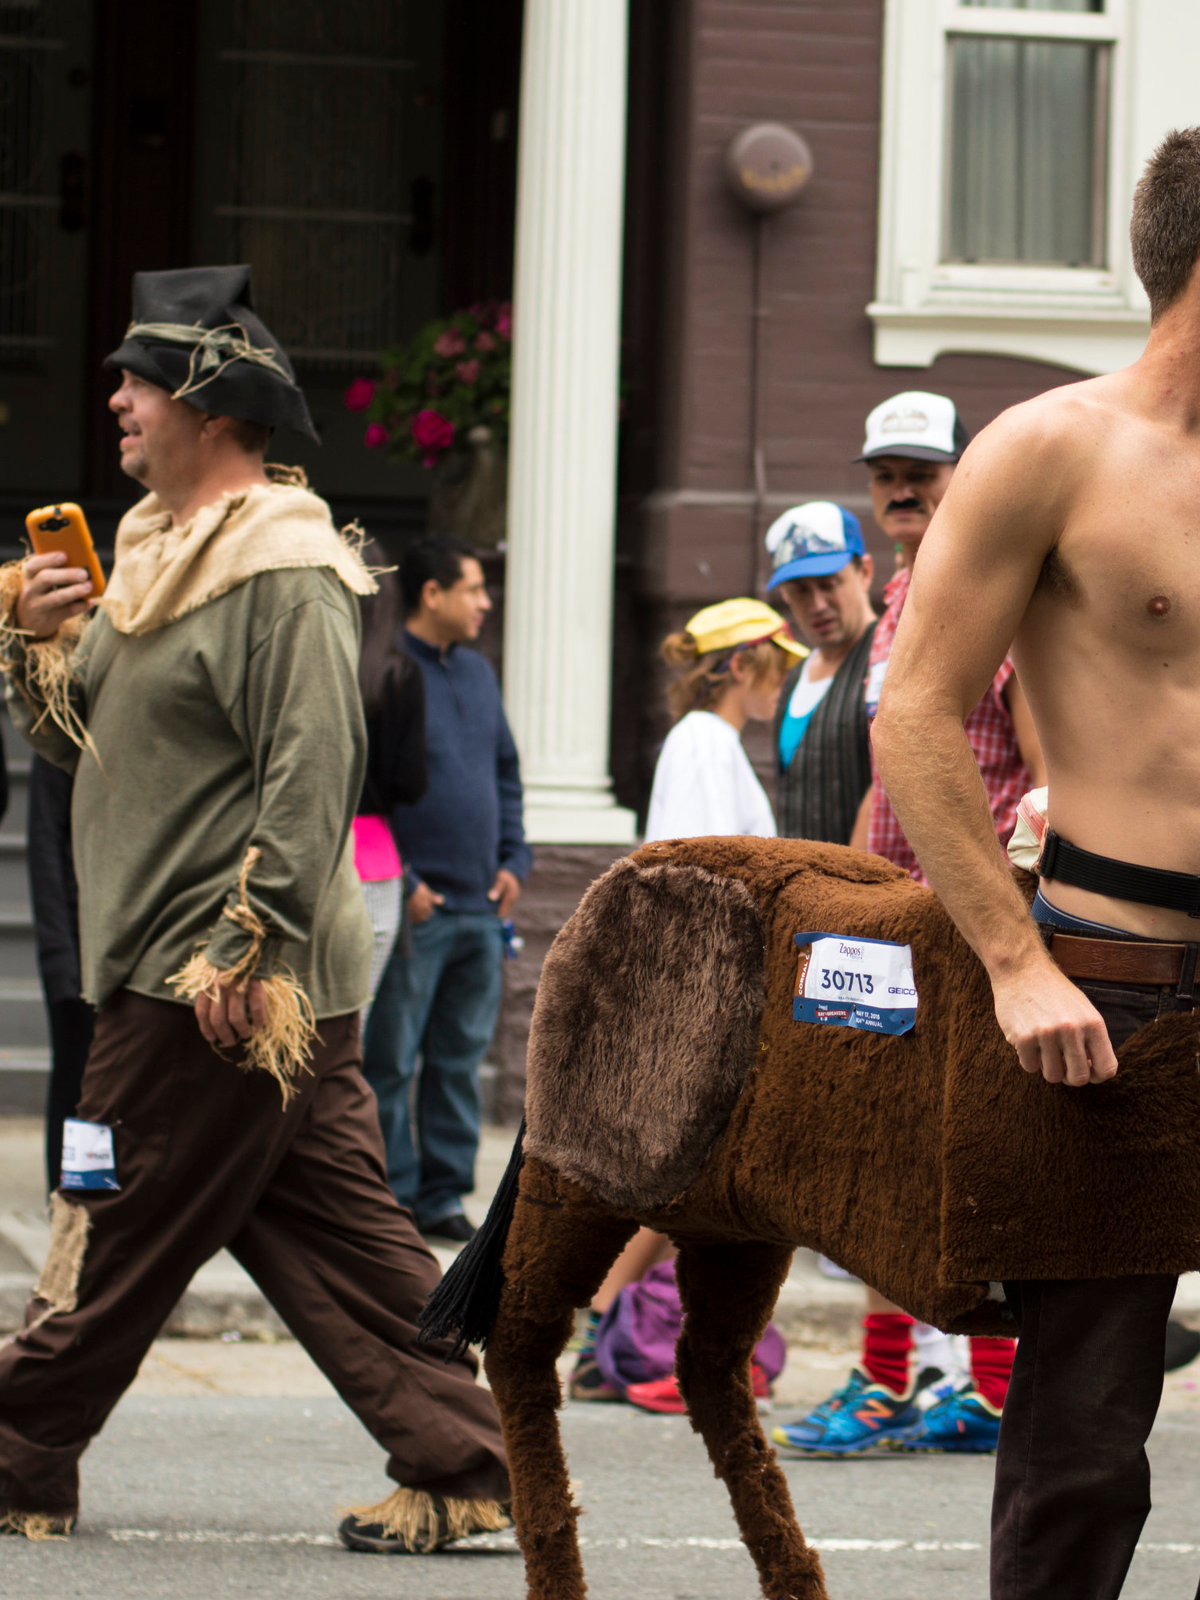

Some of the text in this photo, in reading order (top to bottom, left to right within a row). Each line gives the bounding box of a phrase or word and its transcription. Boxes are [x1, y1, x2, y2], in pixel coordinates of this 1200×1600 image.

[839, 942, 861, 957] Zappos
[798, 961, 808, 995] CORRAL
[821, 969, 874, 994] 30713
[888, 987, 916, 996] GEICO
[865, 1019, 883, 1028] ANNUAL
